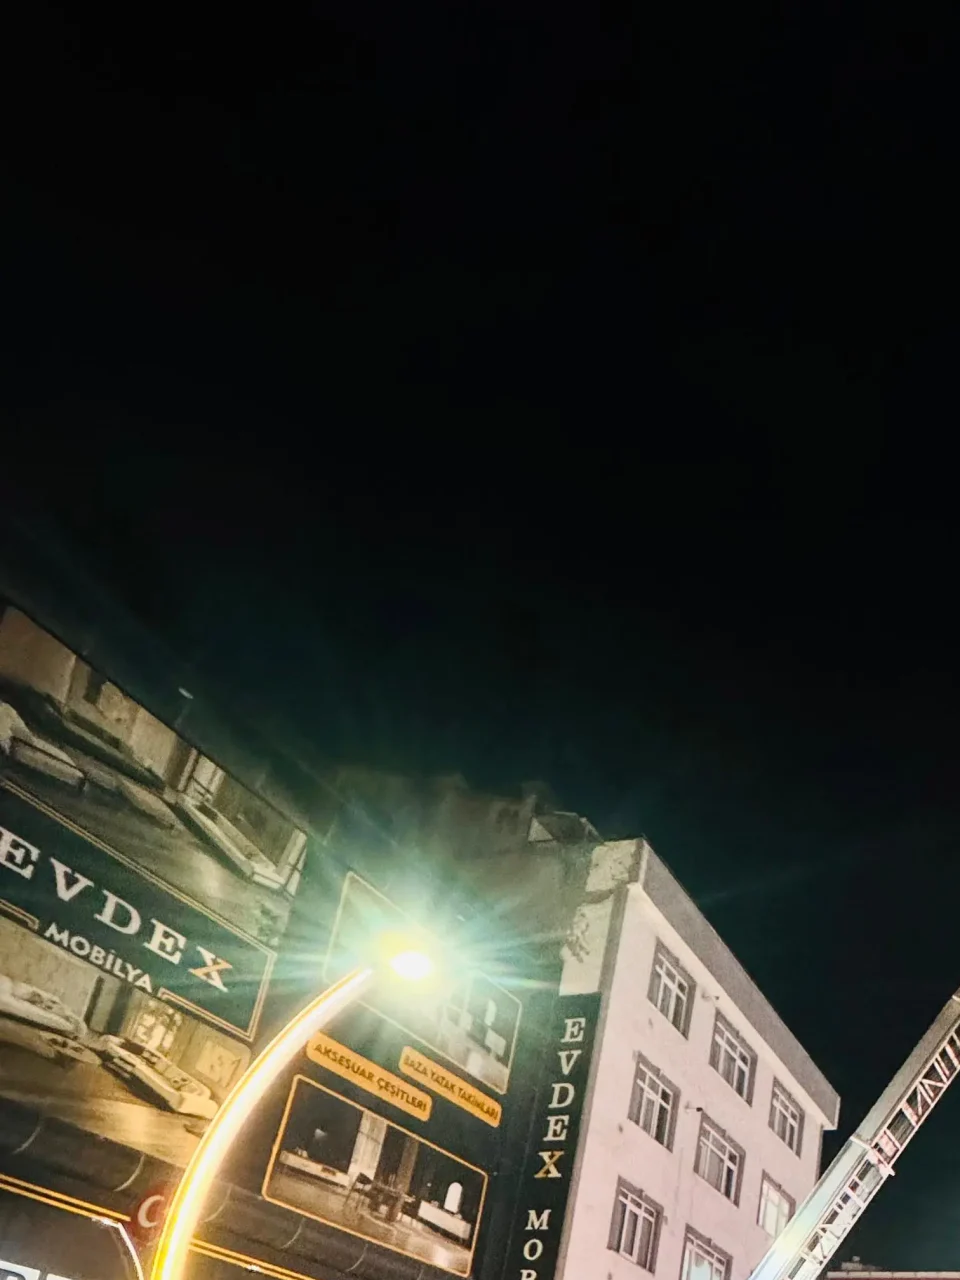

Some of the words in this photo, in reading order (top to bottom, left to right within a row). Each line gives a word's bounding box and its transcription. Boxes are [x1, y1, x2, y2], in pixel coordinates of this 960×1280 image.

[0, 826, 233, 993] EVDEX
[44, 922, 153, 993] MOBİLYA
[315, 1043, 374, 1081] AKSESUAR
[534, 1017, 588, 1178] EVDEX
